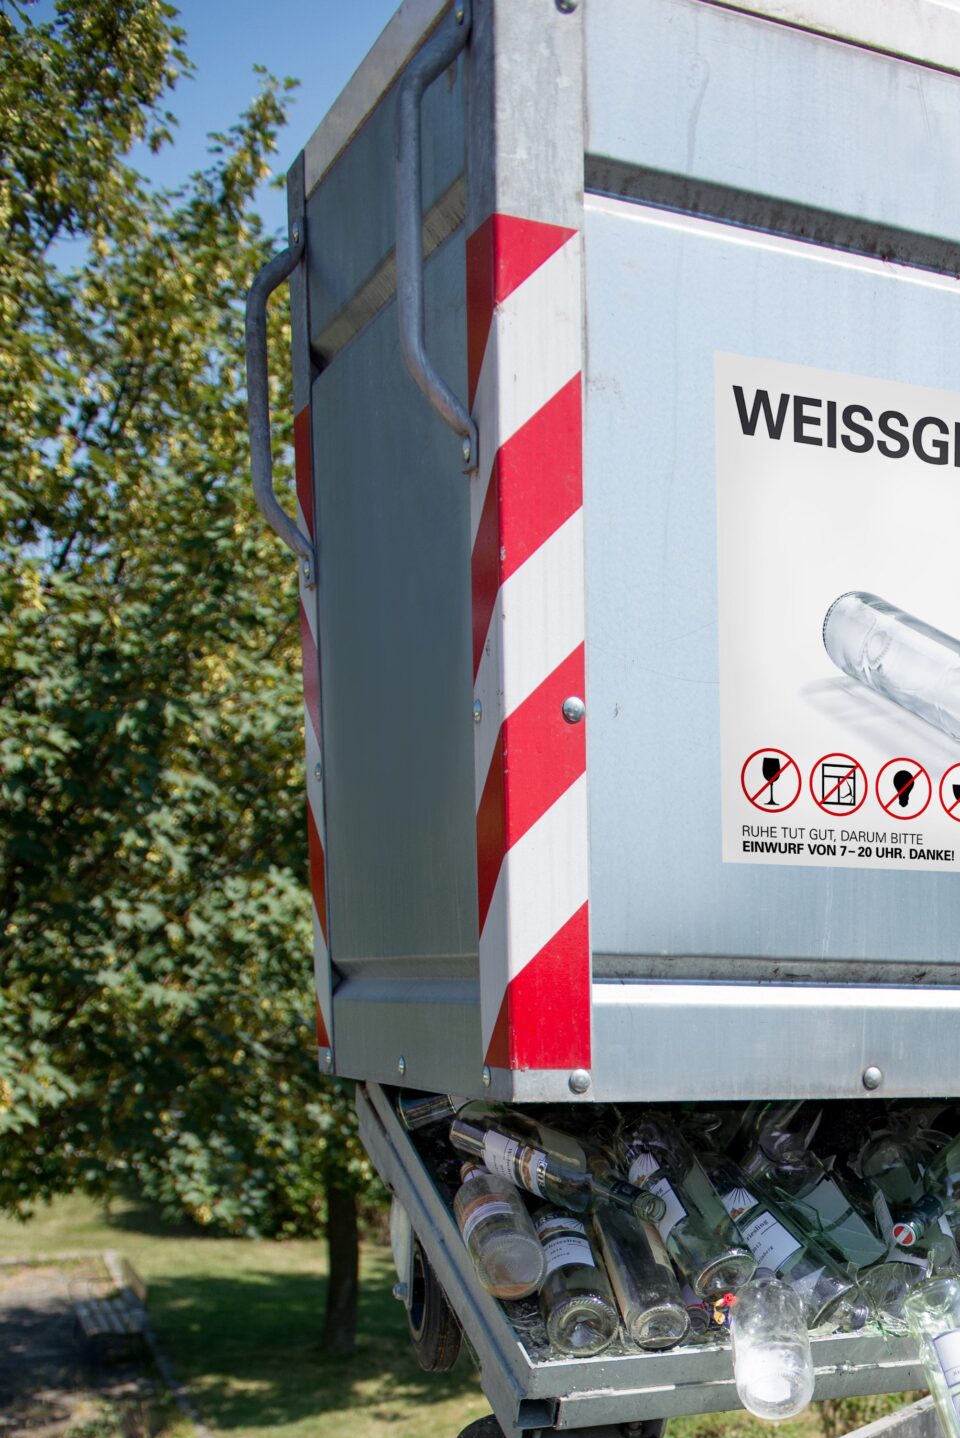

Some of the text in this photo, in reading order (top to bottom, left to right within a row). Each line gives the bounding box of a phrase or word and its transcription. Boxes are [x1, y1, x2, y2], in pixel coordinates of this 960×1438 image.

[742, 825, 923, 845] RUHE TUT GUT, DARUM BITTE
[742, 841, 804, 856] EINWURF
[807, 844, 837, 857] VON
[875, 846, 906, 860] UHR.
[909, 848, 955, 861] DANKE!
[745, 1217, 769, 1241] riesling
